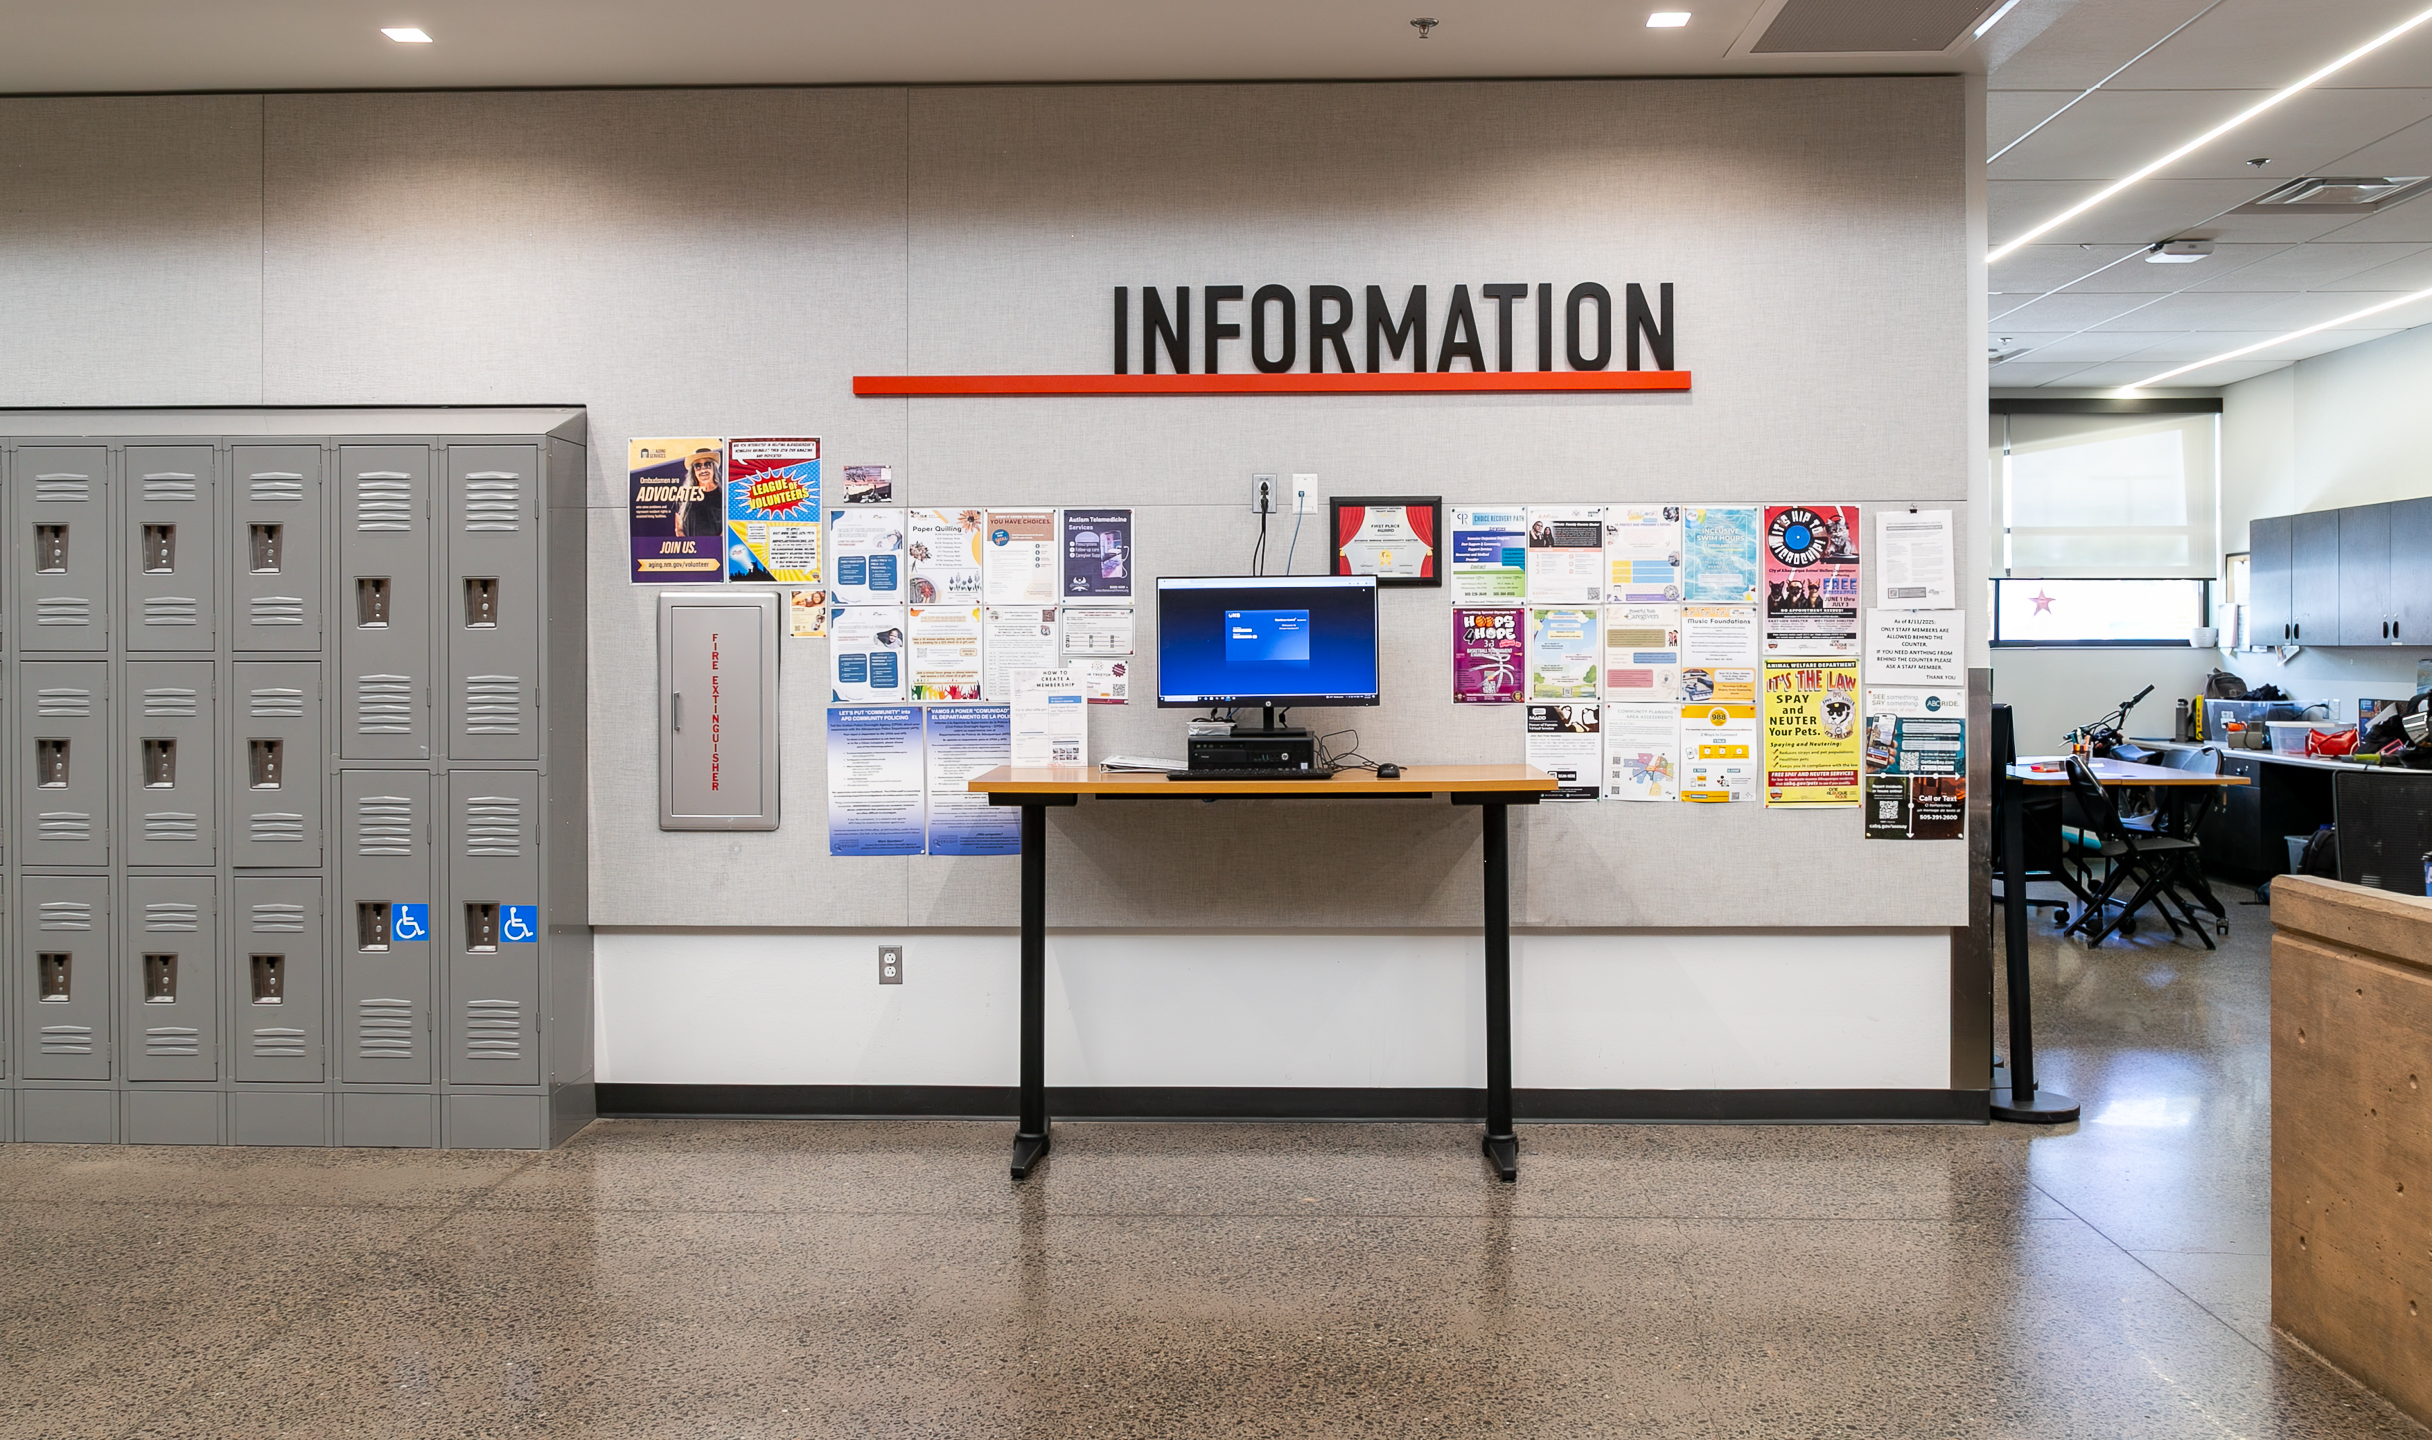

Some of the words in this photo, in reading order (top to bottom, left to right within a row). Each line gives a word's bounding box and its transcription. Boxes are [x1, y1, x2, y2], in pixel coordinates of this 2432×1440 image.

[1114, 282, 1674, 374] INFORMATION
[752, 478, 788, 496] LEAGUE
[789, 481, 798, 490] OF
[636, 486, 706, 502] ADVOCATES
[749, 488, 810, 510] VOLUNTEERS
[1772, 514, 1791, 536] IT'S
[1791, 510, 1812, 523] HIP
[1809, 520, 1824, 534] TO
[660, 541, 682, 554] JOIN
[682, 541, 697, 554] US.
[1768, 535, 1826, 565] MICROCHIP!
[1823, 578, 1857, 590] FREE
[1464, 615, 1515, 628] HOOPS
[1628, 612, 1659, 621] Caregivers
[1766, 672, 1792, 692] IT'S
[1796, 670, 1823, 692] THE
[1827, 671, 1857, 692] LAW
[1776, 694, 1809, 704] SPAY
[1782, 706, 1804, 715] and
[1770, 716, 1817, 725] NEUTER
[1769, 727, 1792, 737] Your
[1795, 727, 1821, 737] Pets.
